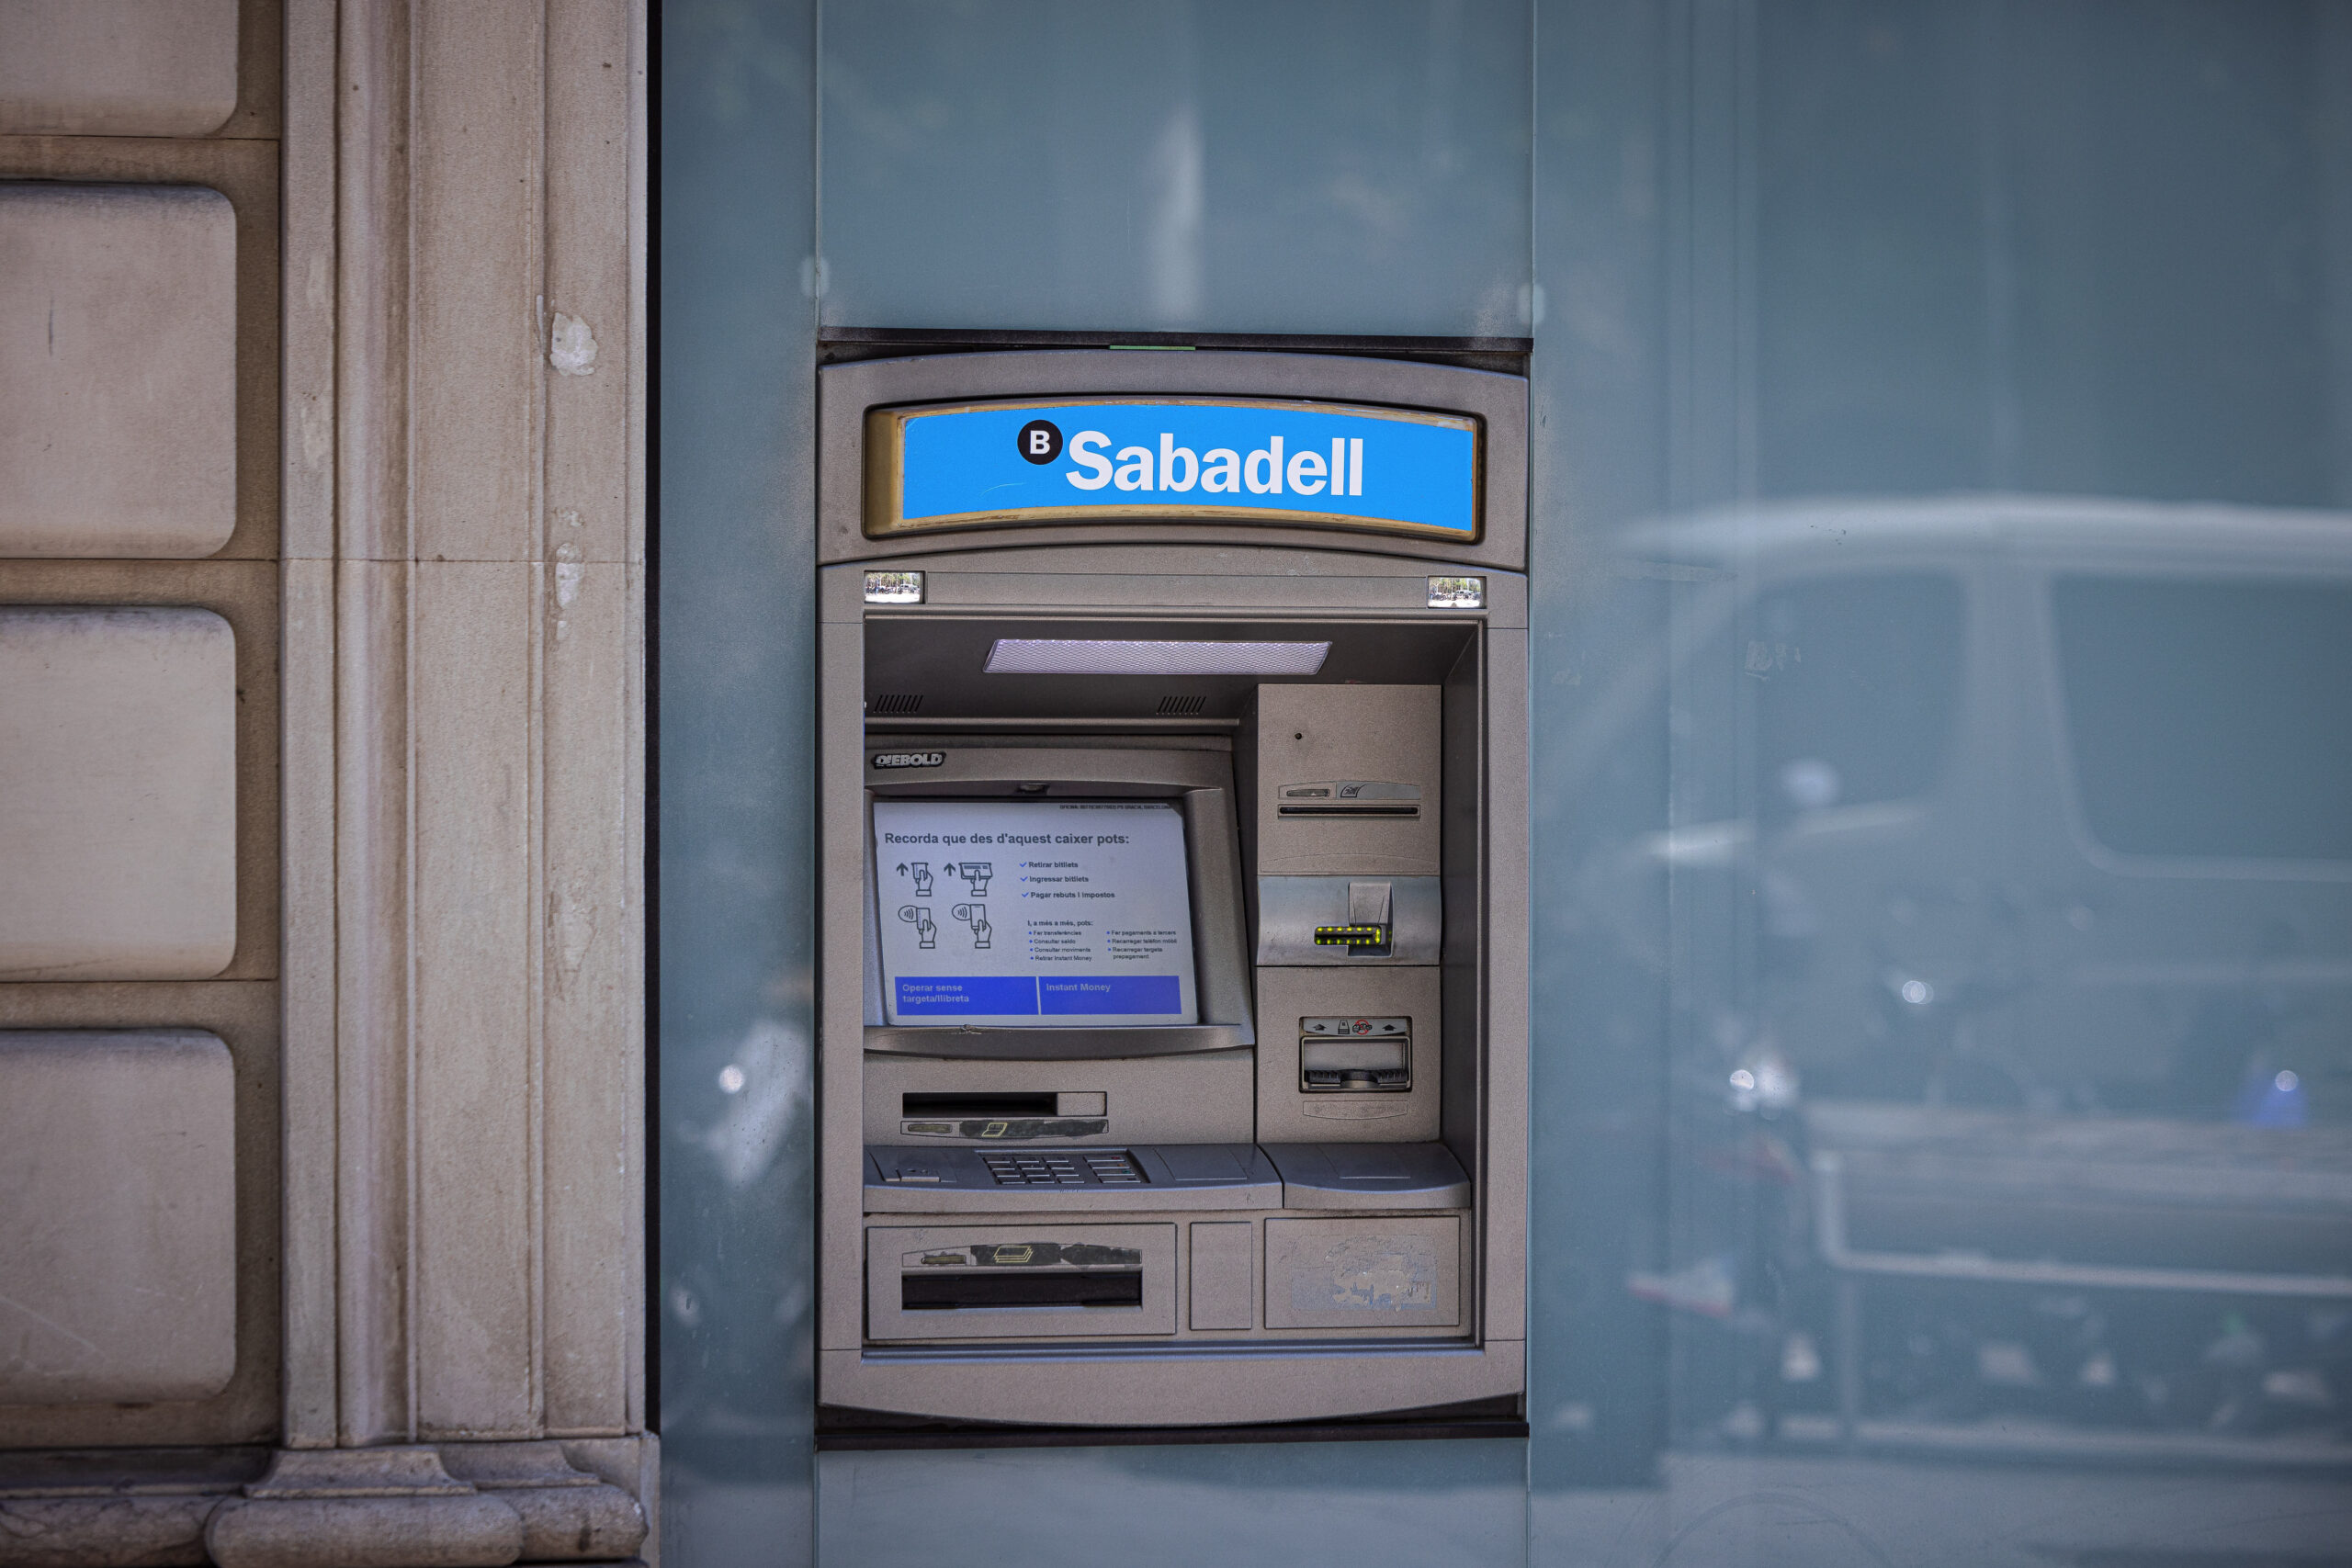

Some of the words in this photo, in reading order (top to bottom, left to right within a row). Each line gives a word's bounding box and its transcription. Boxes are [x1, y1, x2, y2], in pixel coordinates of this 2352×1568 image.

[1029, 430, 1050, 455] B
[1066, 430, 1363, 496] Sabadell
[885, 833, 938, 844] Recorda
[942, 835, 966, 847] que
[970, 833, 993, 844] des
[997, 833, 1051, 847] d'aquest
[1055, 833, 1093, 844] caixer
[1097, 834, 1129, 847] pots:
[902, 984, 933, 994] Operar
[1080, 984, 1111, 993] Money
